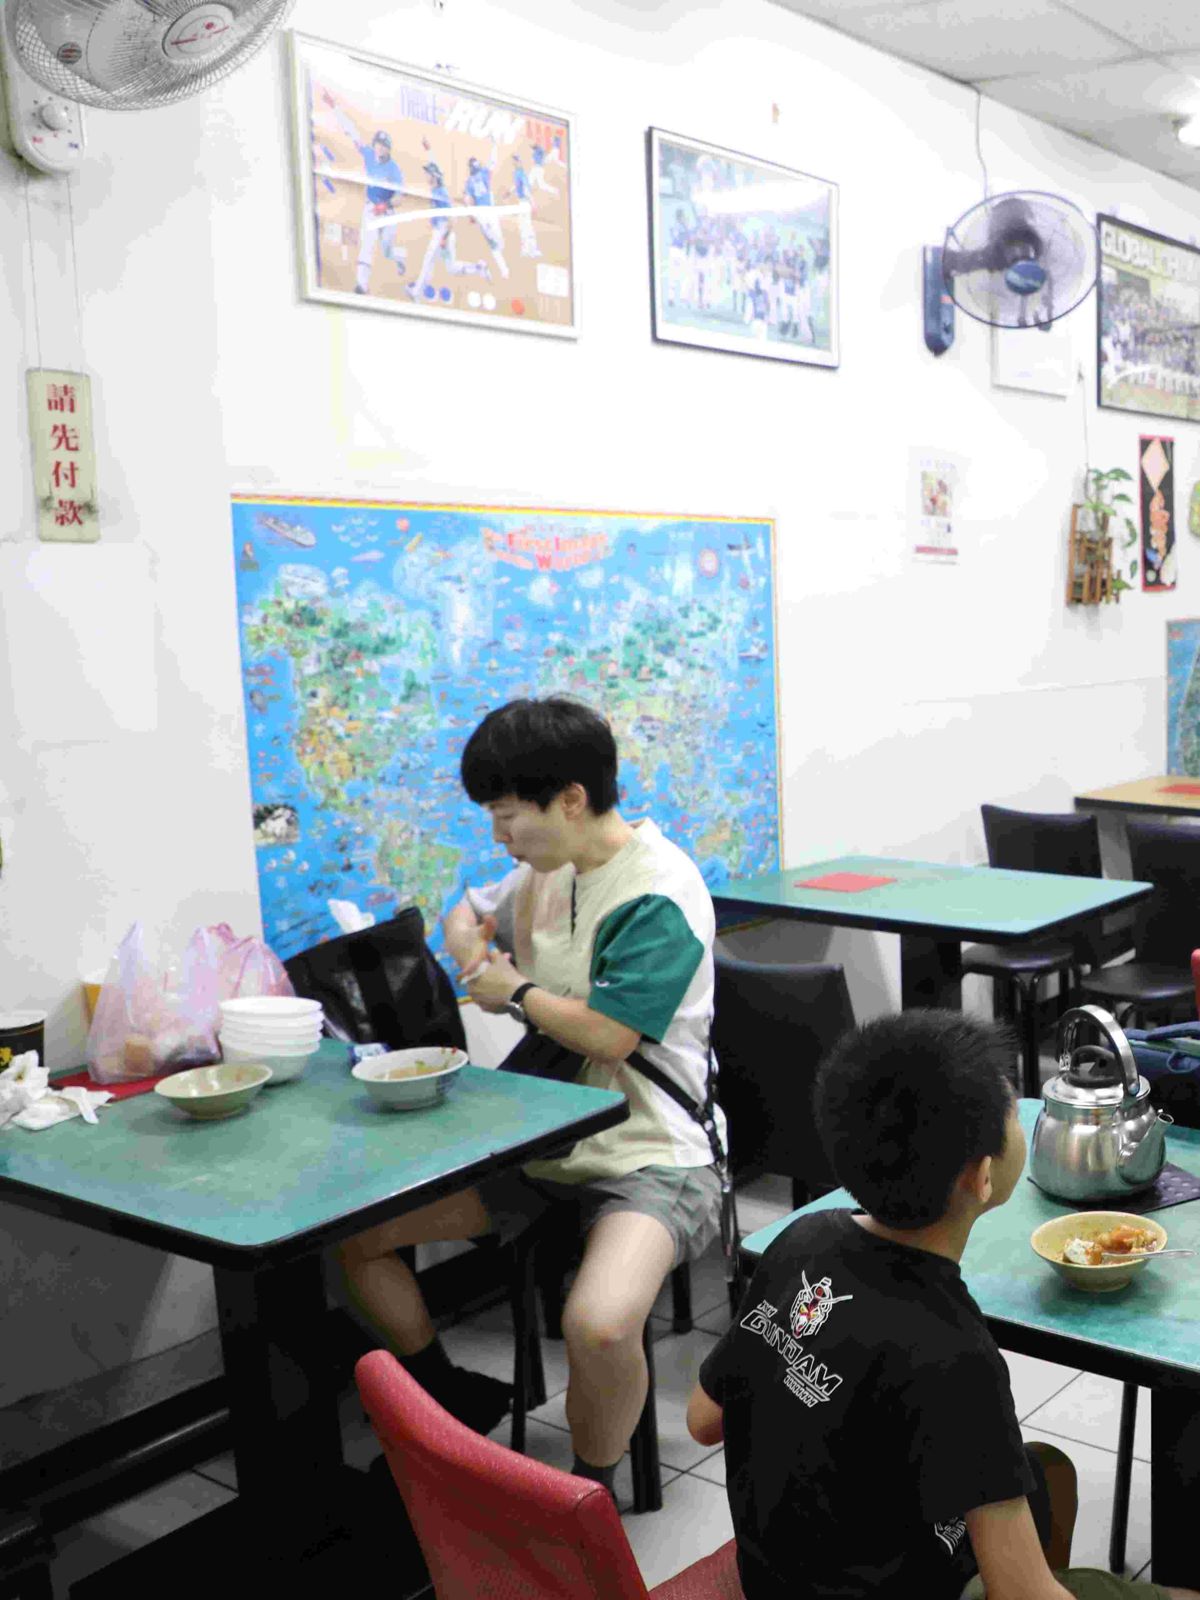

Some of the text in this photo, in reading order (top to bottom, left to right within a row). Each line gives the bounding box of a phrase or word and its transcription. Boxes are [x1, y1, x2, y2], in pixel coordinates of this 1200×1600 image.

[46, 383, 84, 526] 請先付款
[739, 1308, 844, 1397] GUNDAM
